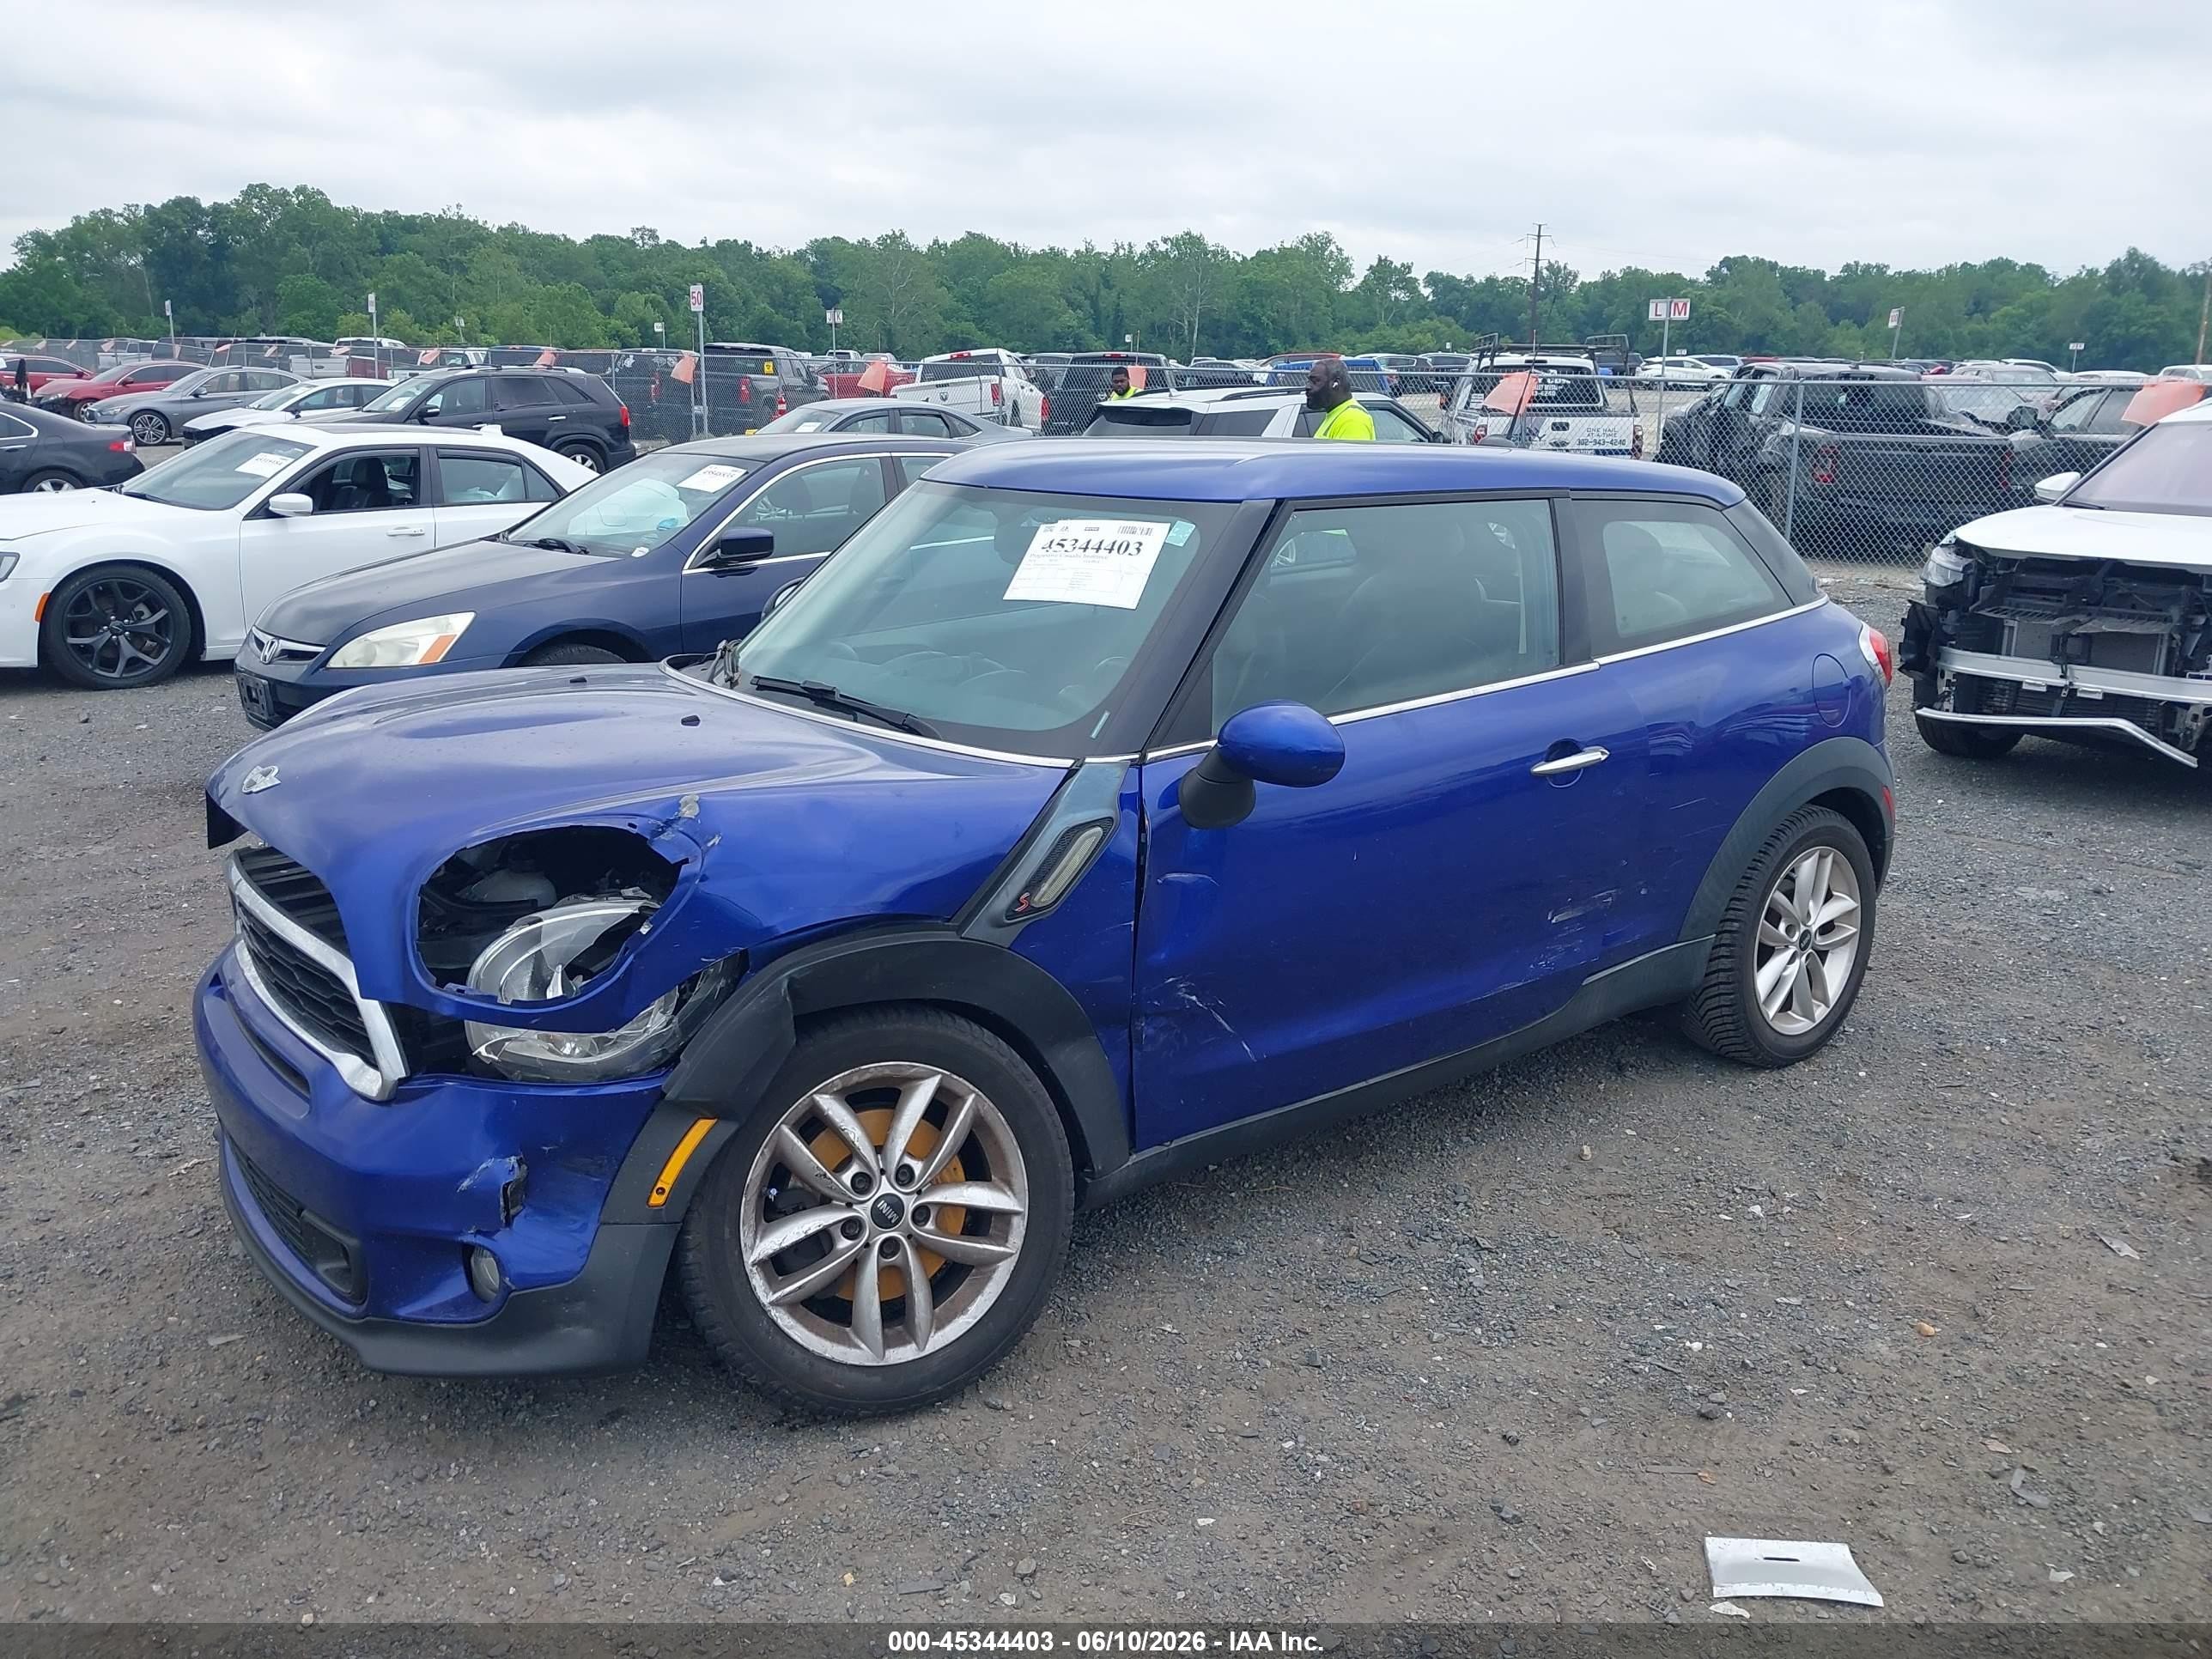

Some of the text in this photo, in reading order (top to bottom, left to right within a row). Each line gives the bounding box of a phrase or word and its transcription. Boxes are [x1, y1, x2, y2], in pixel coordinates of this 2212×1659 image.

[691, 290, 702, 306] 50
[1654, 302, 1688, 317] L M
[1577, 438, 1626, 447] 302-943-4240
[1041, 538, 1144, 556] 45344403
[1013, 891, 1030, 912] S
[877, 1200, 899, 1224] MINI
